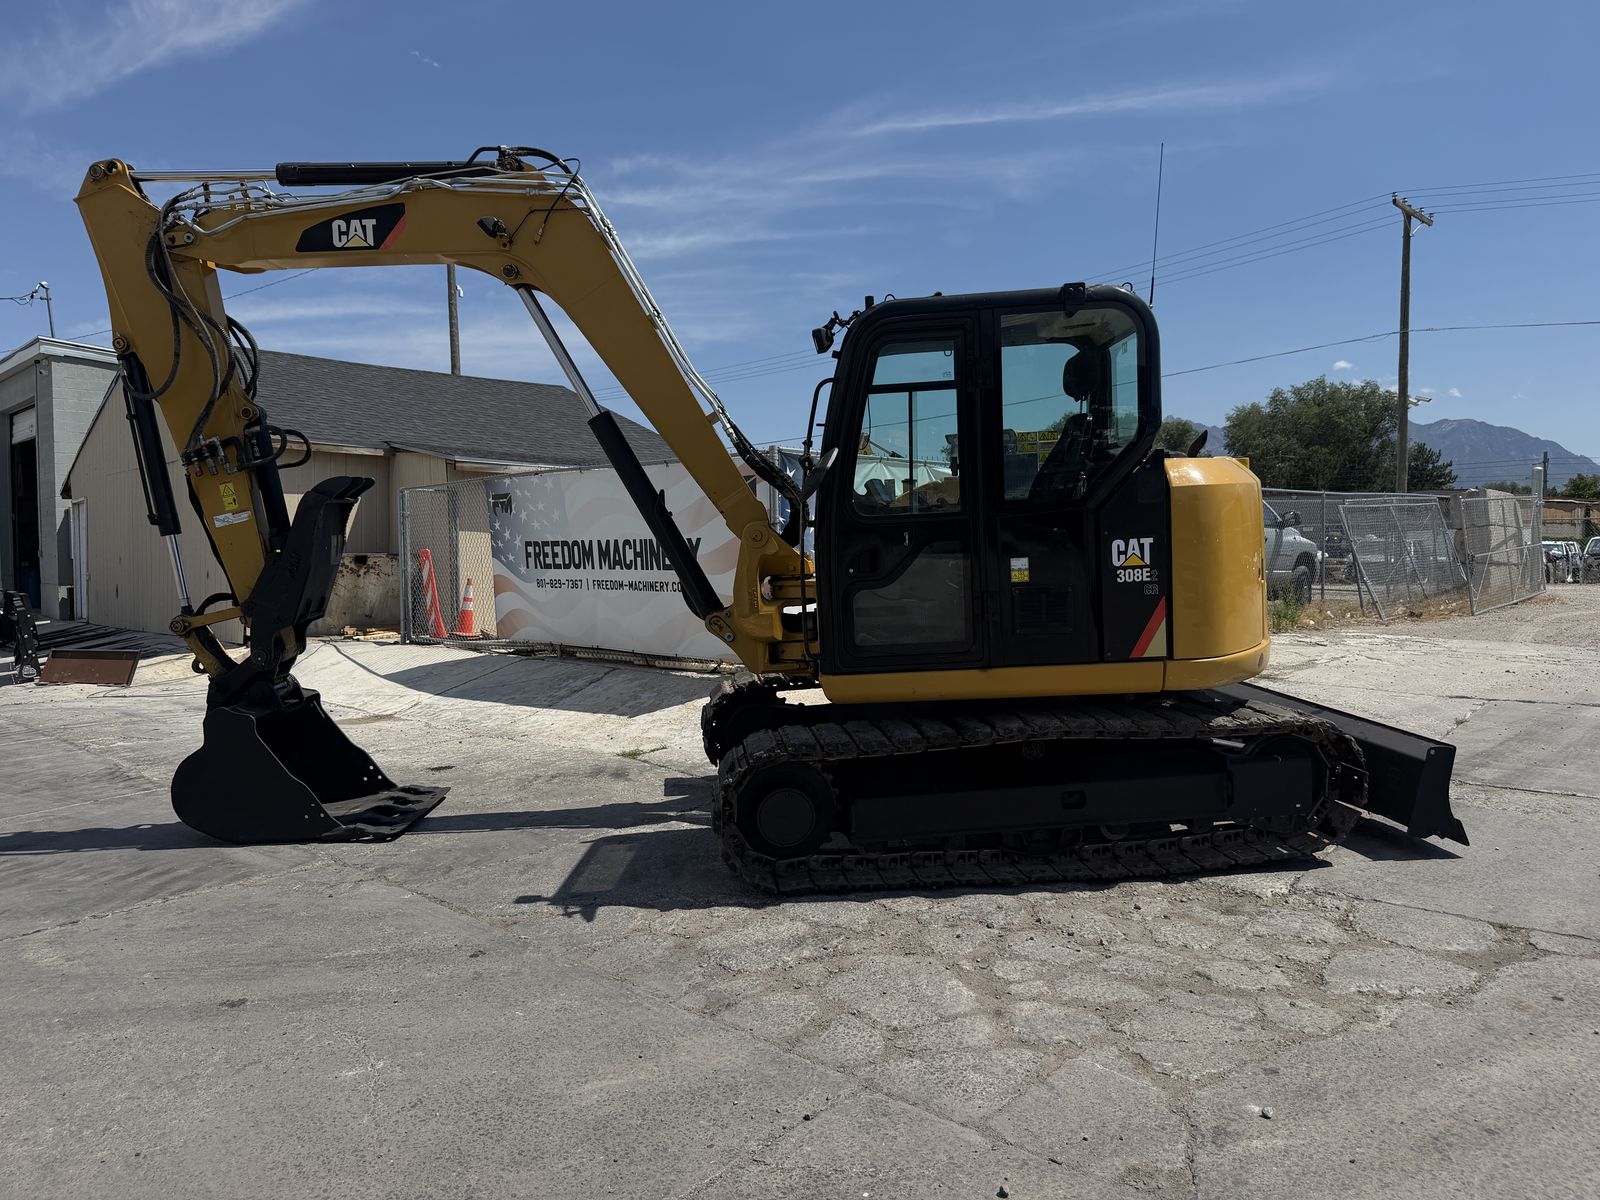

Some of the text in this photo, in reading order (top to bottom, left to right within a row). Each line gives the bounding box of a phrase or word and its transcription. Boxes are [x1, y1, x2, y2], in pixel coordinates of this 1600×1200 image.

[331, 218, 377, 248] CAT
[524, 537, 701, 570] FREEDOM MACHINEY
[1111, 537, 1154, 567] CAT
[536, 579, 583, 589] 801-829-7367
[593, 579, 682, 593] FREEDOM-MACHINERY.CO
[1143, 583, 1159, 595] CR
